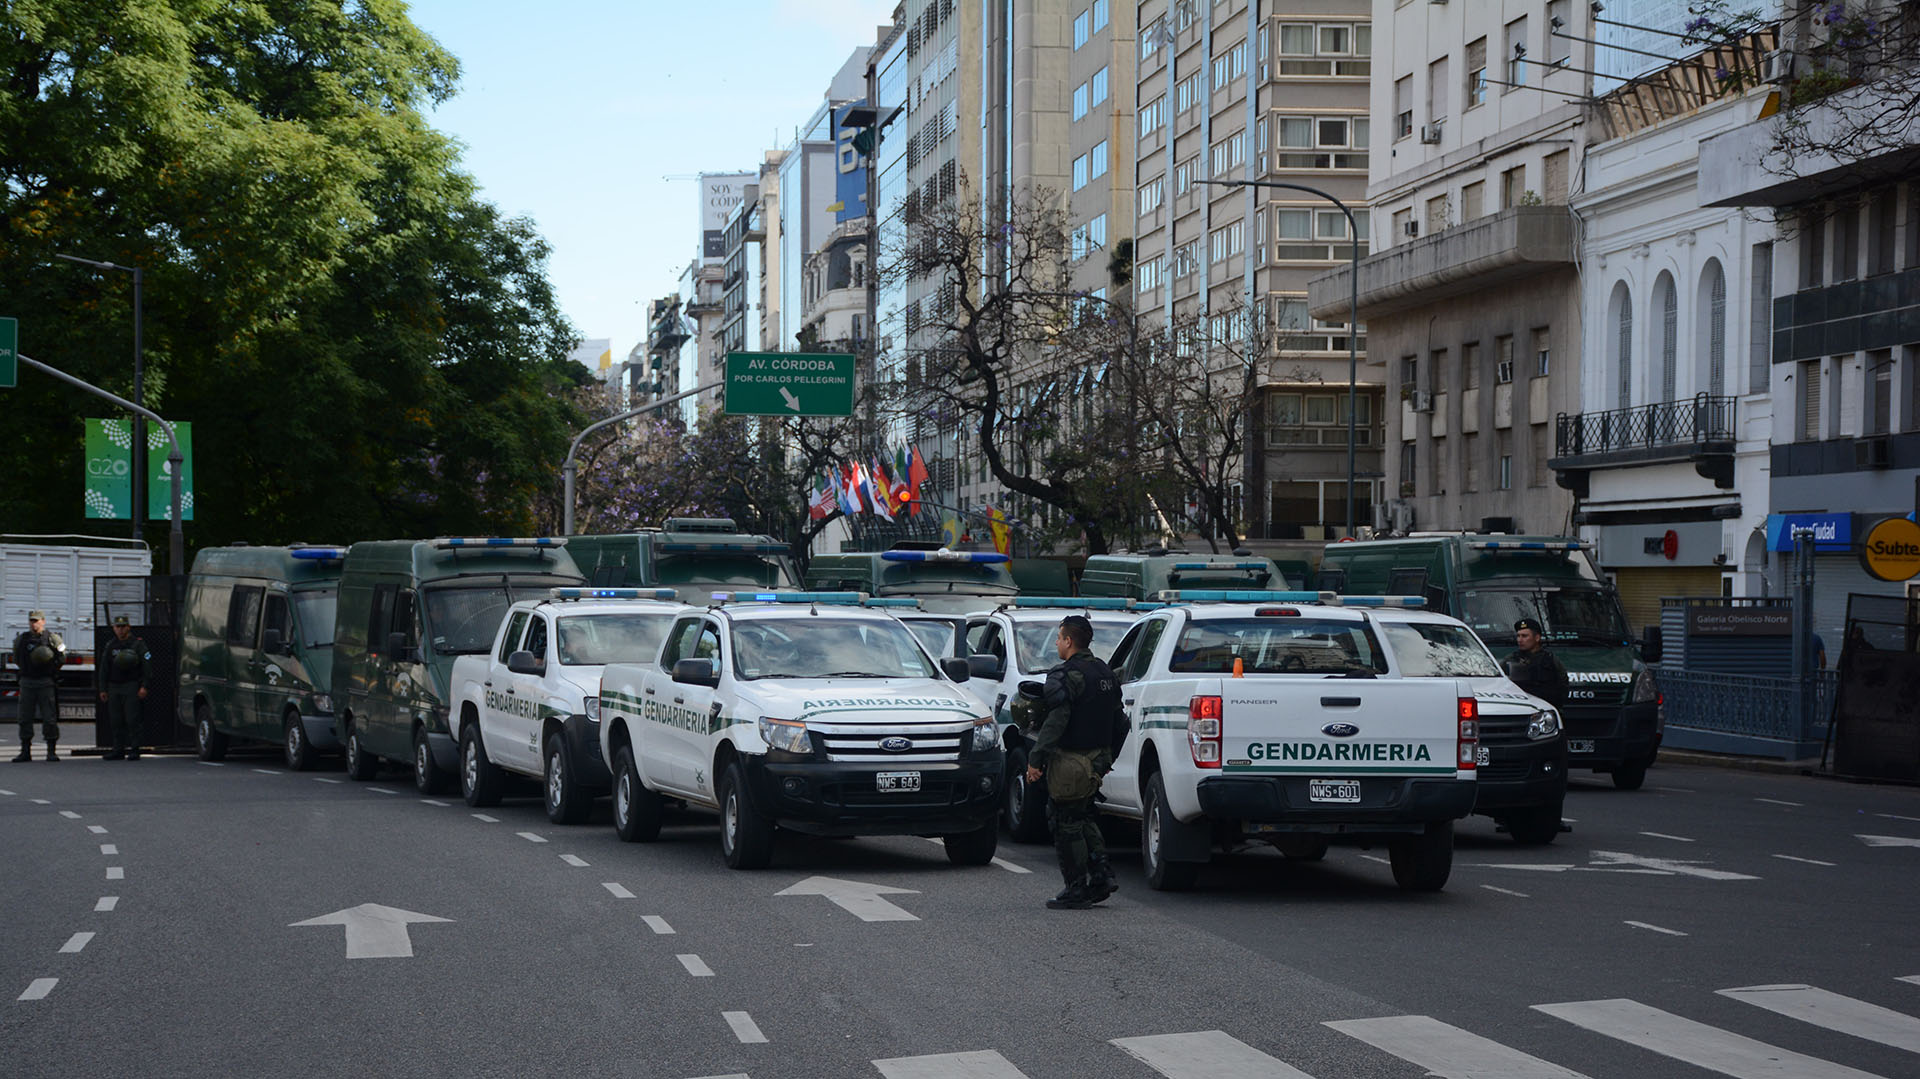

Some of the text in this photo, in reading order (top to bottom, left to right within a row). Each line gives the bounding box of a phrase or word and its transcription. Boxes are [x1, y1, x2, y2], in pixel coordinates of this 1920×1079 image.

[711, 184, 731, 194] SOY
[748, 358, 836, 371] AV. CÓRDOBA
[756, 375, 792, 383] CARLOS
[794, 376, 846, 384] PELLEGRINI
[87, 458, 129, 475] G20
[1870, 540, 1920, 556] Subte
[1727, 615, 1763, 624] Obelisco
[1764, 615, 1788, 624] Norte
[485, 690, 538, 721] GENDARMERIA
[644, 699, 707, 735] GENDARMERIA
[1330, 724, 1353, 735] Ford
[886, 739, 907, 749] Ford
[1247, 742, 1431, 761] GENDARMERIA
[900, 776, 919, 788] 643
[1311, 784, 1359, 799] NWS 601
